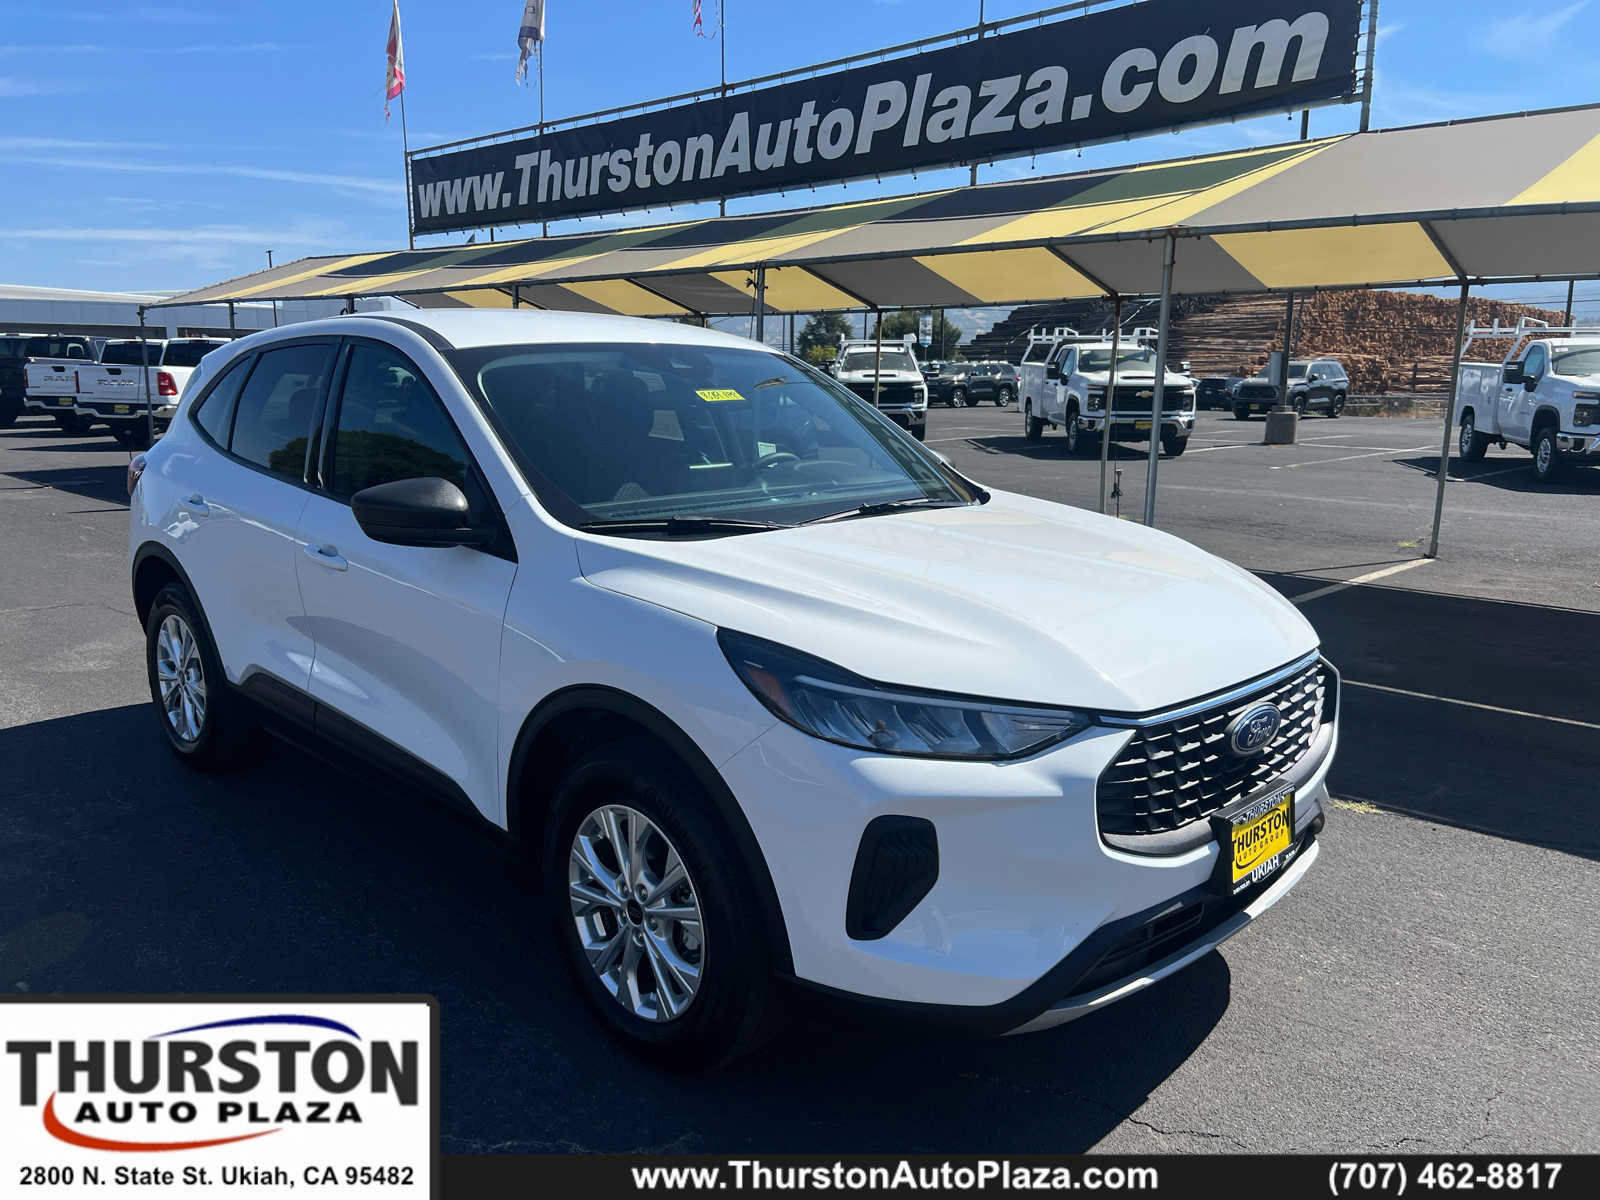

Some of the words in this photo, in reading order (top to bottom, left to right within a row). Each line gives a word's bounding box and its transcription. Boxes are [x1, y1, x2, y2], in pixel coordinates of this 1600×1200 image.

[418, 11, 1330, 218] www.ThurstonAutoPlaza.com
[1247, 716, 1274, 746] Ford
[1232, 808, 1290, 862] THURSTON
[1252, 855, 1280, 881] UKIAH
